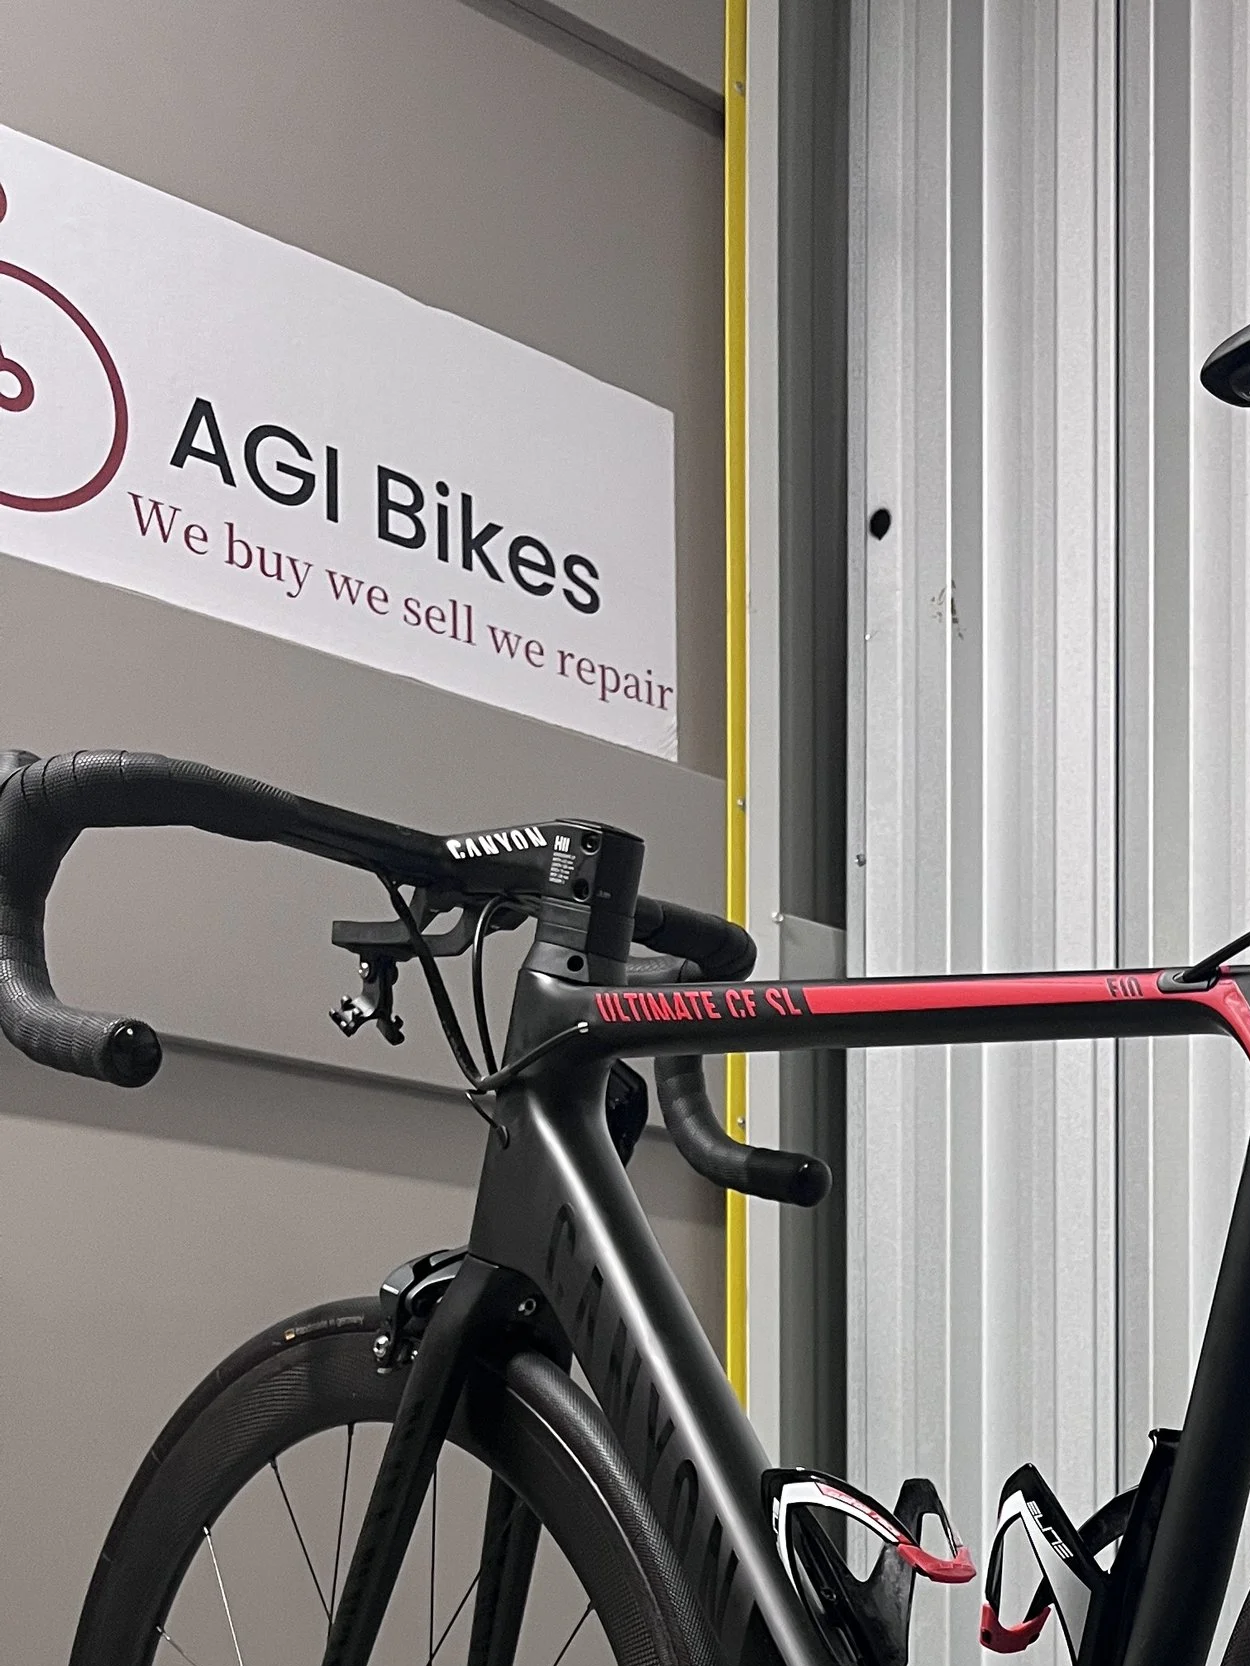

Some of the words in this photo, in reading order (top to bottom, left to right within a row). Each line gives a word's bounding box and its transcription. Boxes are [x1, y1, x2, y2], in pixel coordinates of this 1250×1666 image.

[169, 397, 338, 523] AGI
[377, 465, 600, 615] Bikes
[128, 491, 209, 555] We
[224, 521, 313, 598] buy
[325, 567, 390, 616] we
[402, 595, 476, 646] sell
[487, 623, 545, 668] we
[556, 646, 675, 712] repair
[446, 826, 548, 860] CANYON
[595, 990, 721, 1022] ULTIMATE
[725, 988, 757, 1019] CF
[765, 987, 803, 1016] SL
